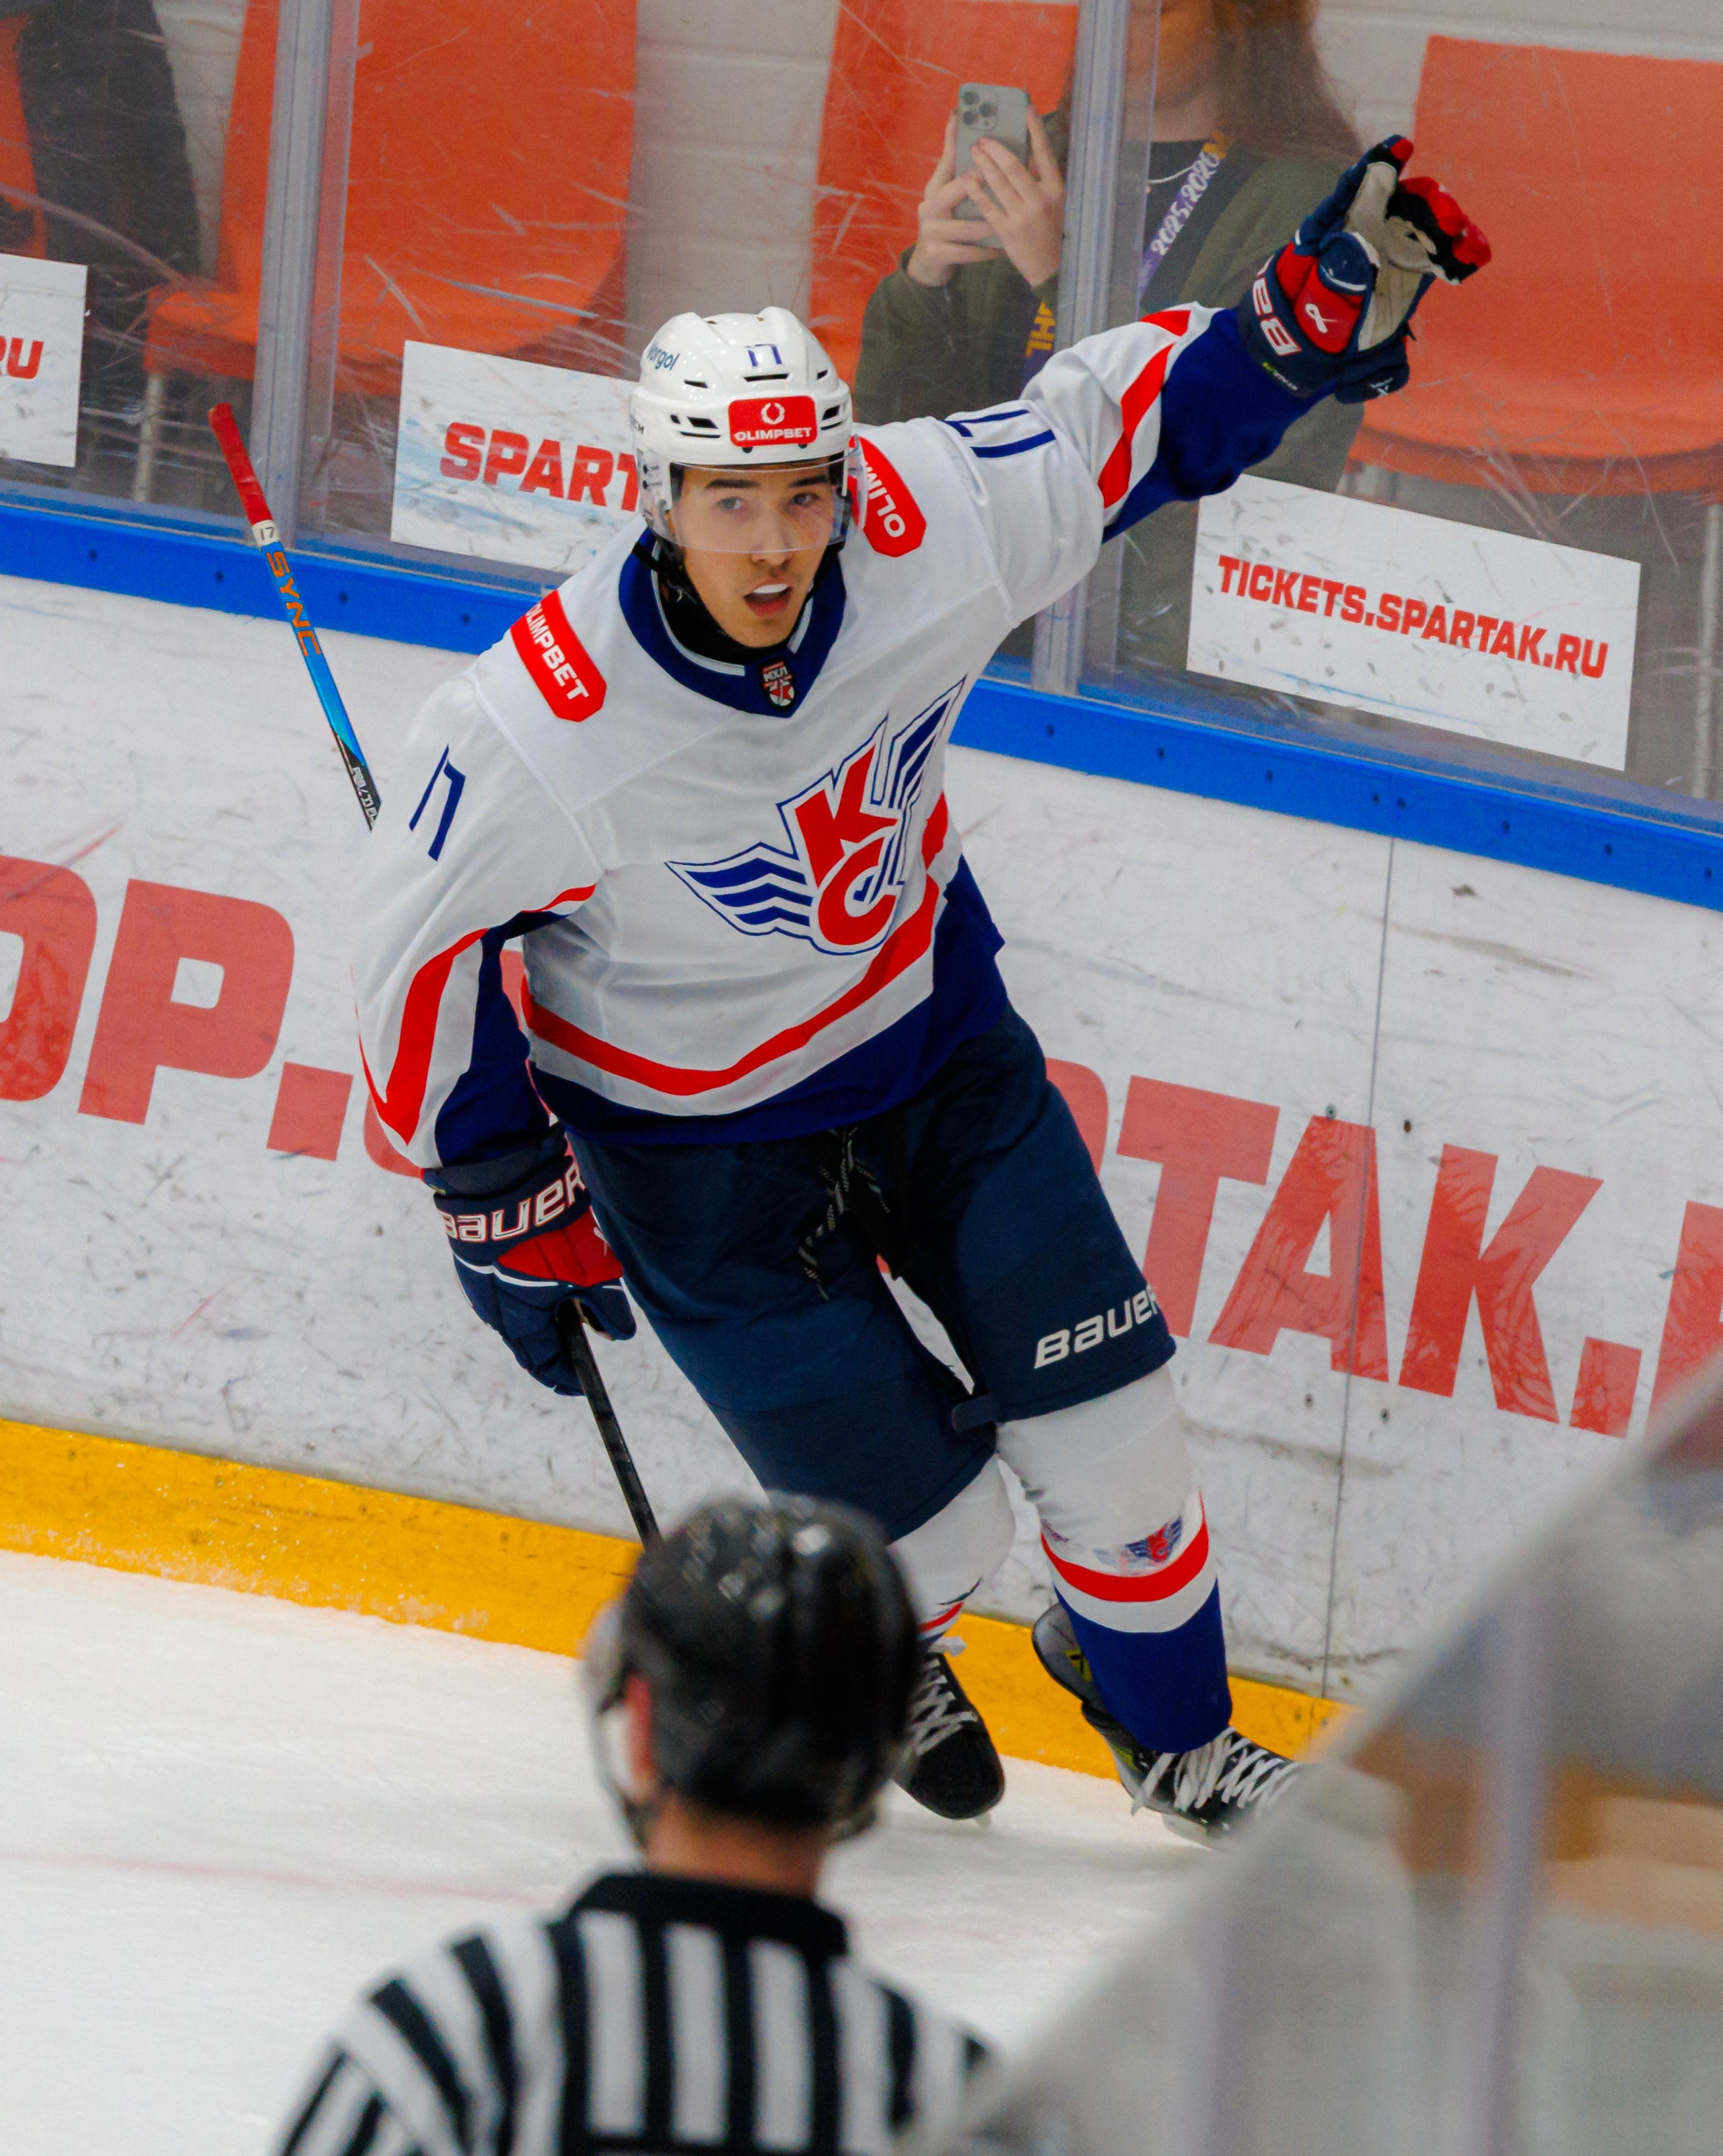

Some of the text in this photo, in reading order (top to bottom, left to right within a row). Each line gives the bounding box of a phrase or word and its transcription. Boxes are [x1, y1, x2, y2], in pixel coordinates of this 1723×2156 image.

[1151, 151, 1220, 256] 2025/2026
[0, 335, 44, 380] U
[734, 427, 812, 442] OLIMPBET
[260, 527, 275, 541] 17
[864, 460, 906, 538] OLIM
[266, 551, 322, 657] SYNC
[1218, 554, 1609, 680] TICKETS.SPARTAK.RU
